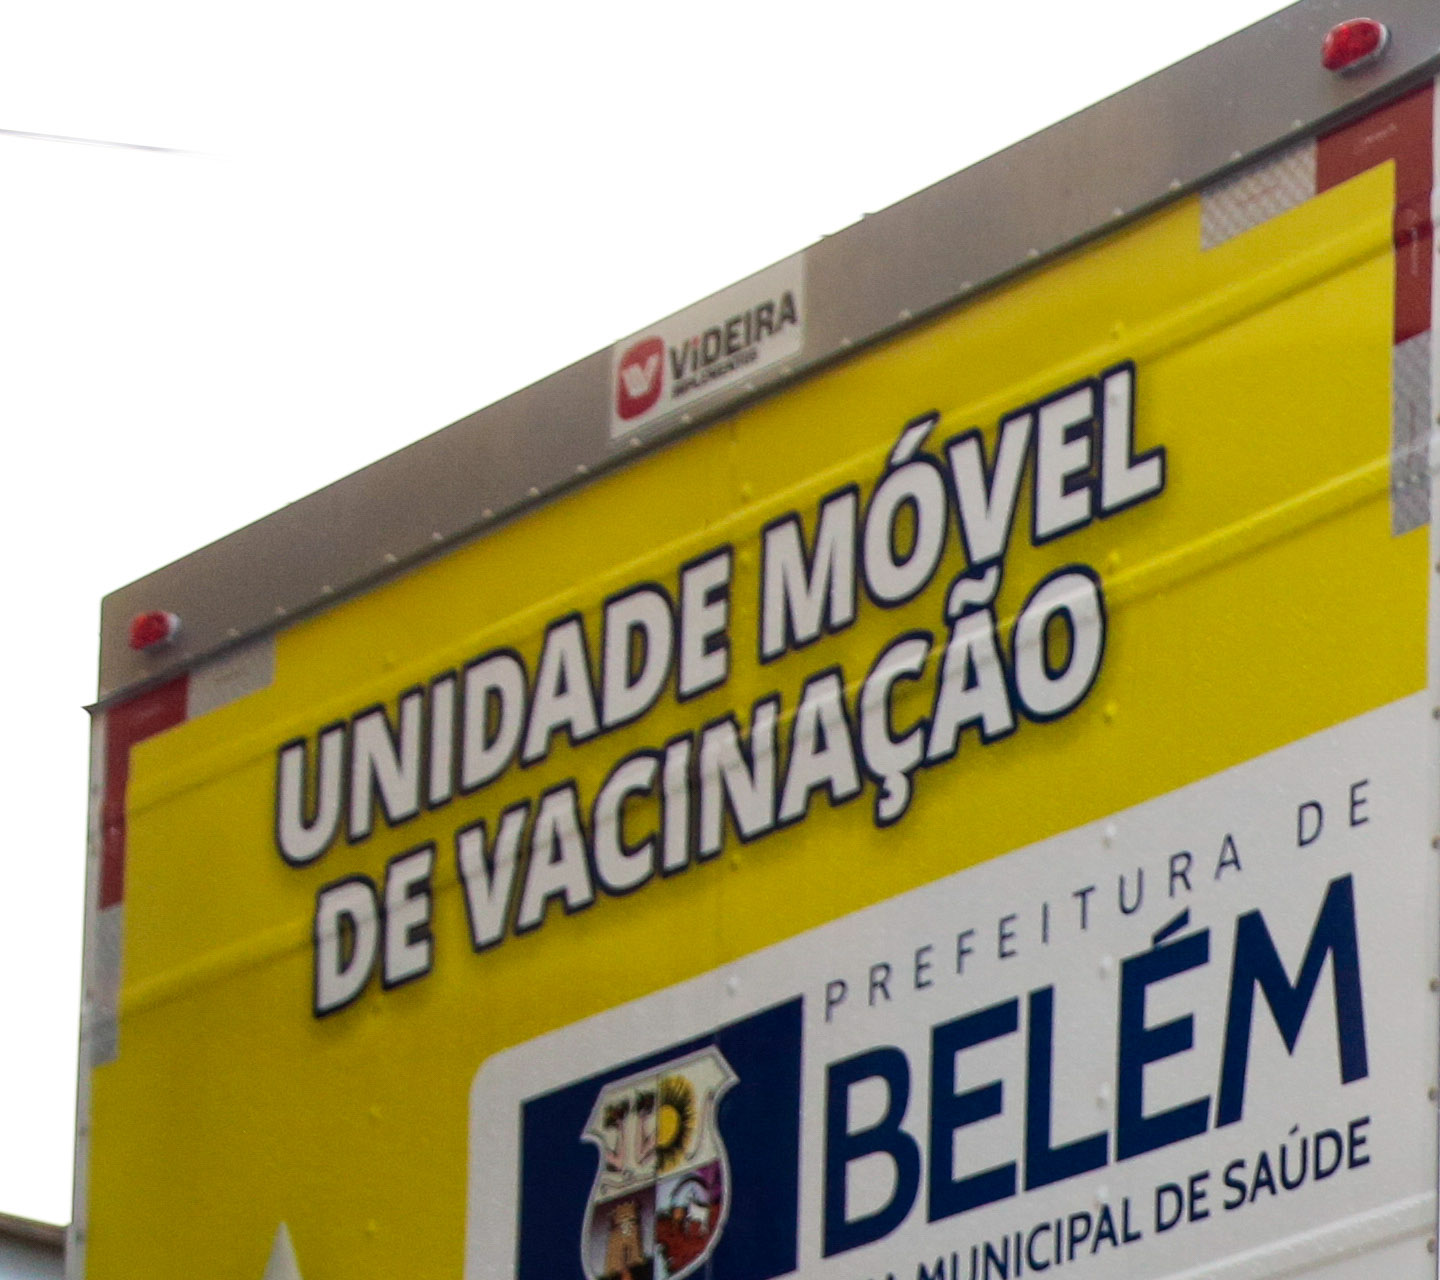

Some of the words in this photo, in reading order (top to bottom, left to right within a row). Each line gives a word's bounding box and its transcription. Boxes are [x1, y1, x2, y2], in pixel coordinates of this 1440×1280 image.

[276, 545, 733, 867] UNIDADE
[760, 360, 1165, 667] MÓVEL
[310, 842, 436, 1019] DE
[454, 561, 1107, 954] VACINAÇÃO
[821, 872, 1369, 1258] BELÉM
[827, 833, 1242, 1022] PREFEITURA
[1298, 779, 1371, 848] DE
[1156, 1172, 1209, 1233] DE
[1223, 1117, 1371, 1207] SAÚDE
